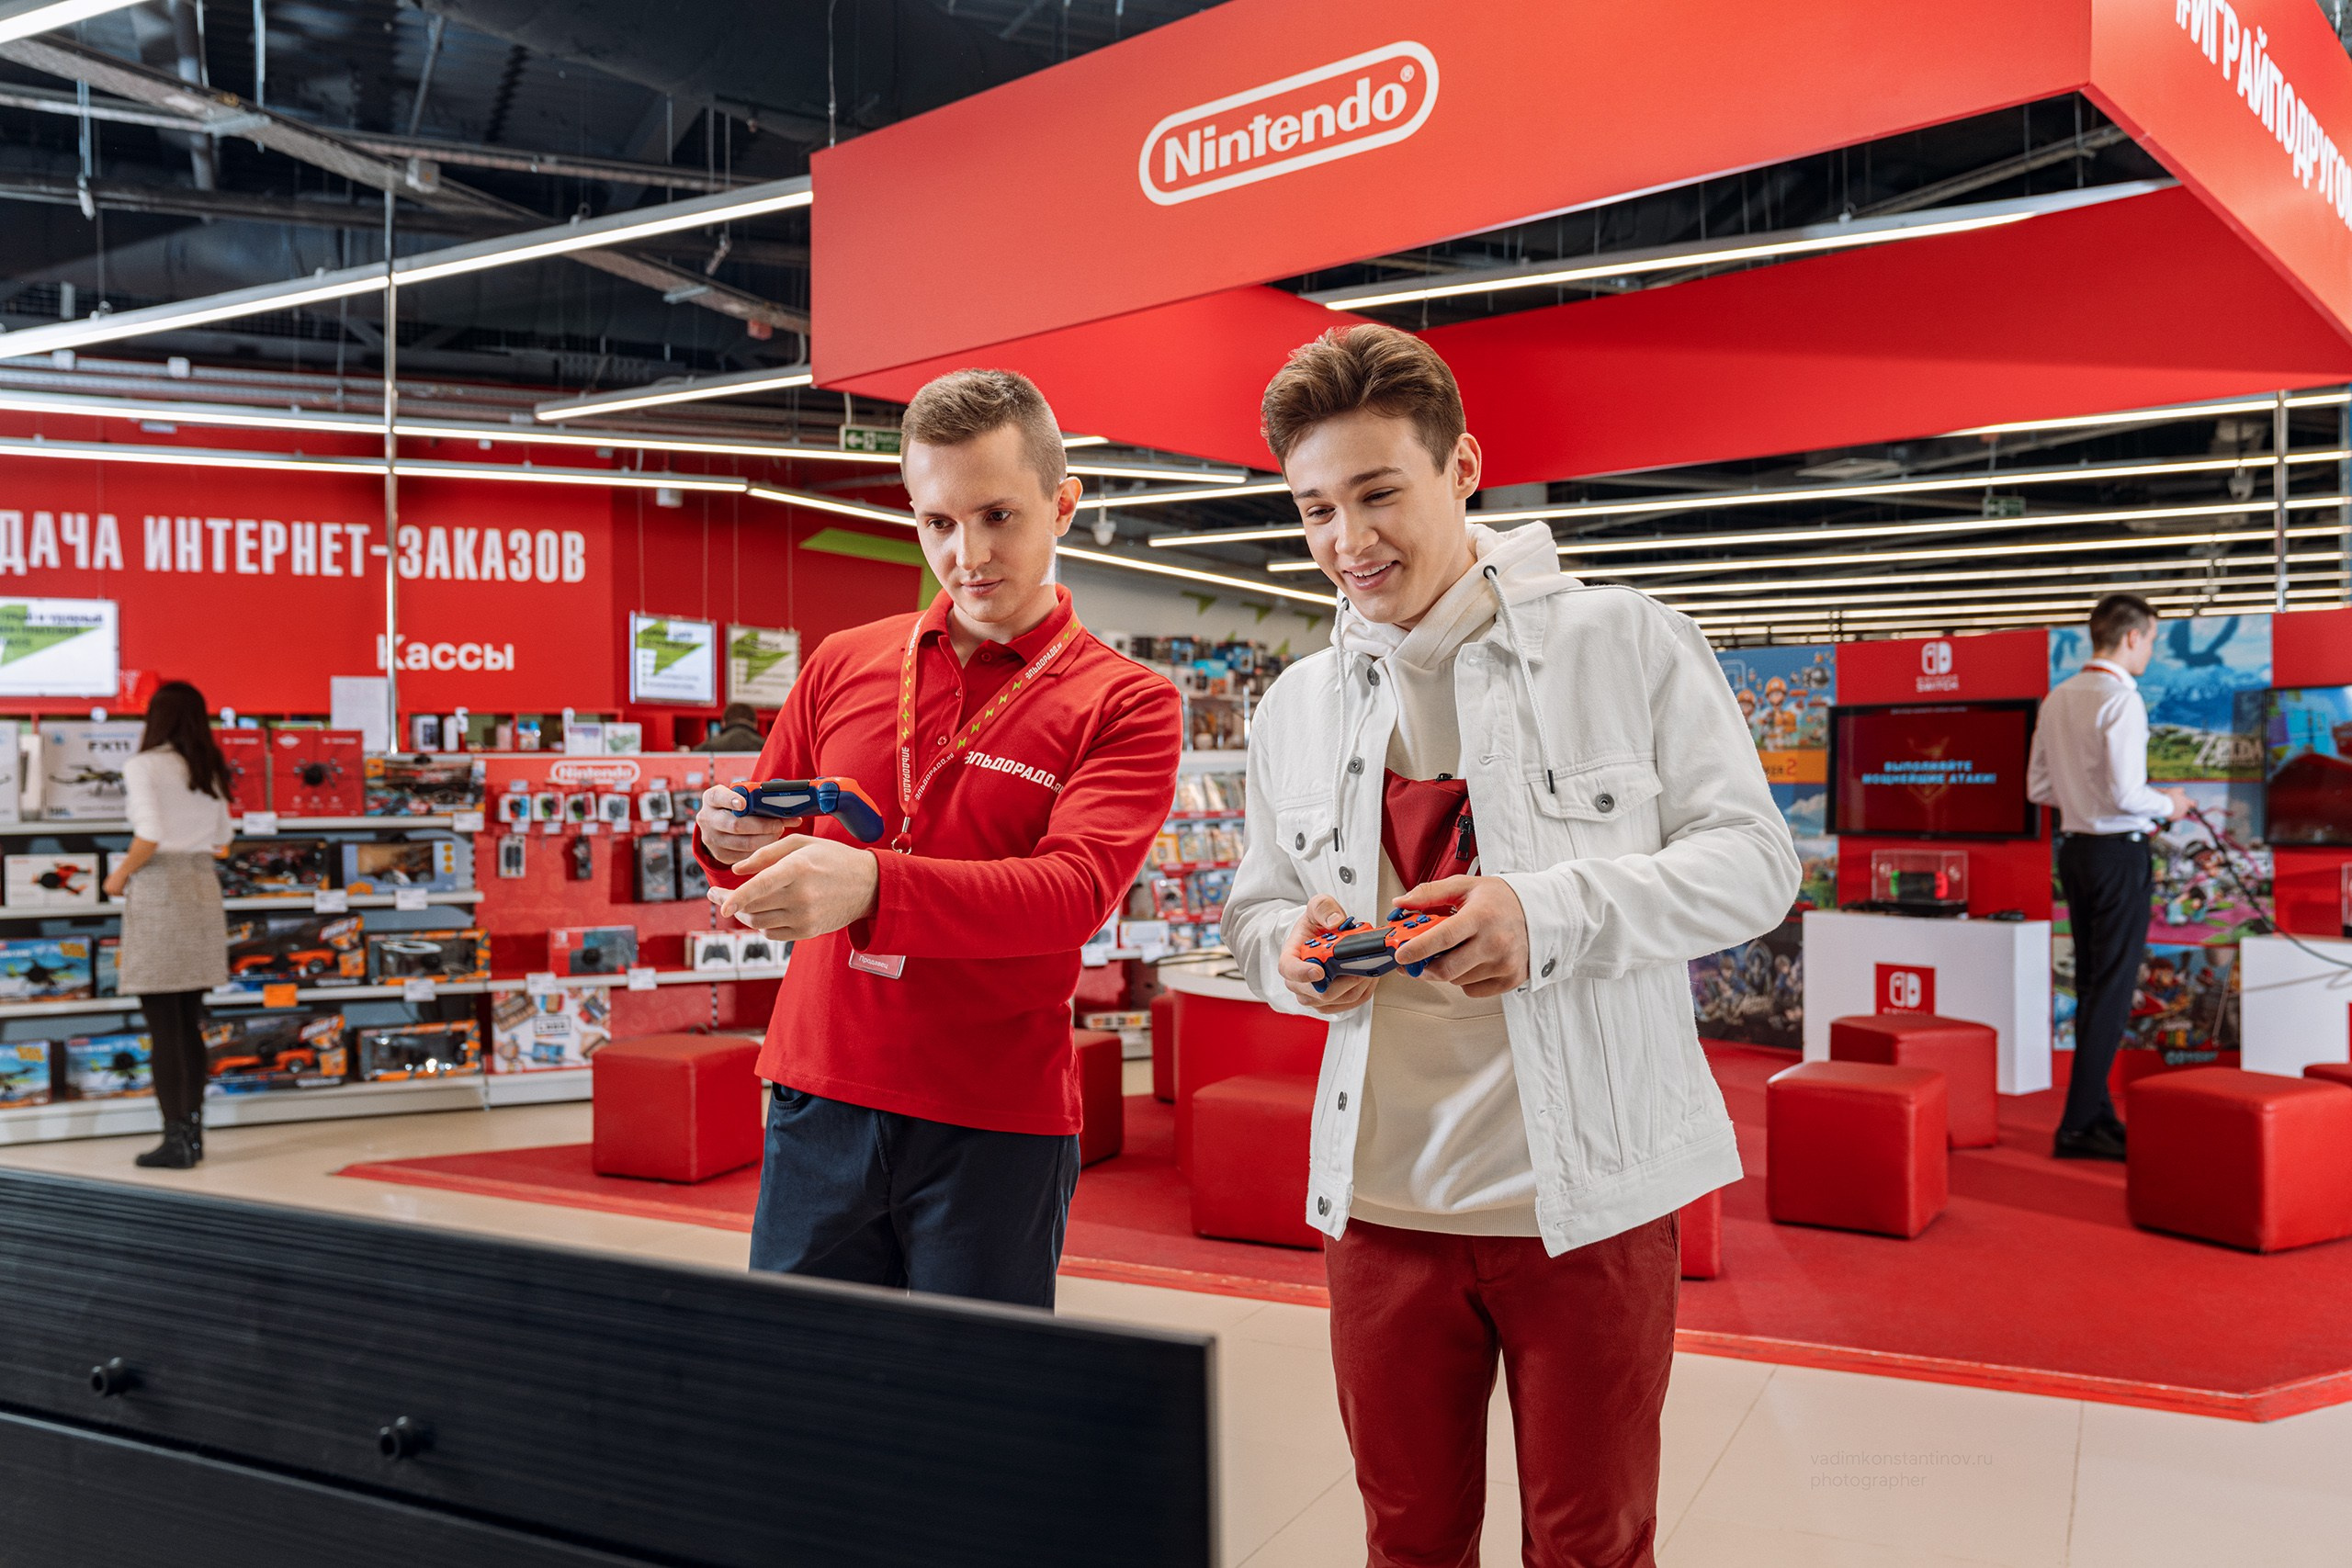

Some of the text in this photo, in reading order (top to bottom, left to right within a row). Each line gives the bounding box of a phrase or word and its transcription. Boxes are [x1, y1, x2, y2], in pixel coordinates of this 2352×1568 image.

[1164, 76, 1408, 184] Nintendo
[143, 514, 586, 583] ИНТЕРНЕТ-ЗАКАЗОВ
[377, 634, 515, 671] Кассы
